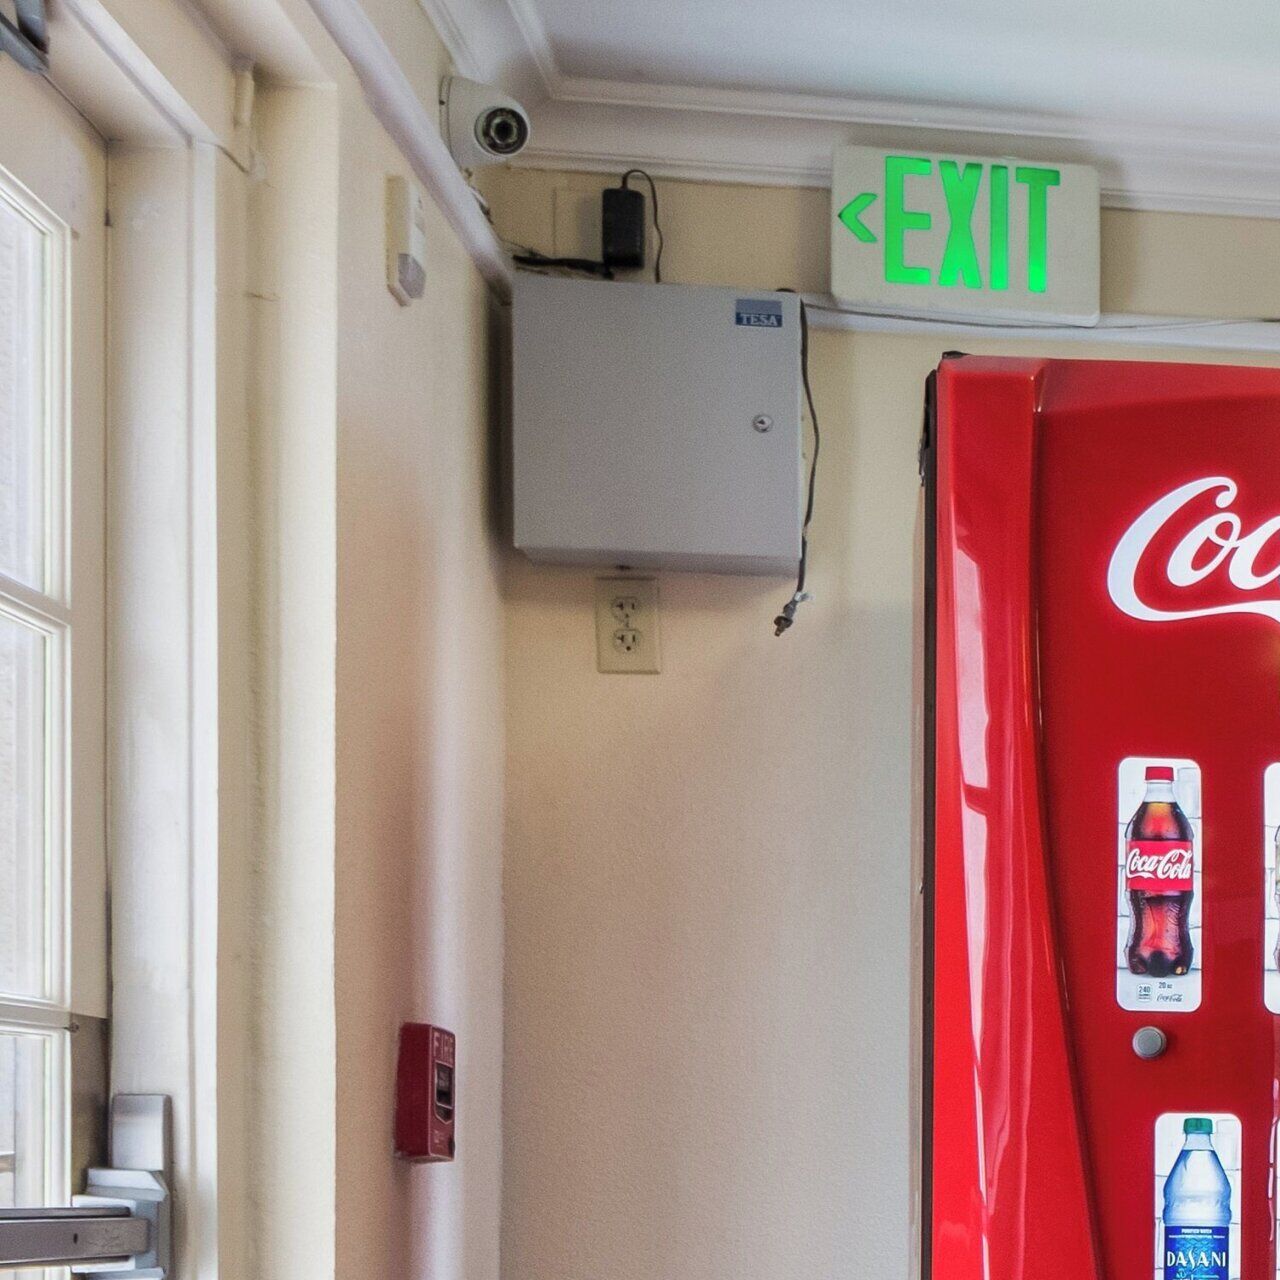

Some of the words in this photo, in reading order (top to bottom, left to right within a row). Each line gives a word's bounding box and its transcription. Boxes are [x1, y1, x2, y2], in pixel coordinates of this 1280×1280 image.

[886, 156, 1060, 294] EXIT
[736, 313, 781, 328] TESA
[1126, 848, 1192, 880] Coca-Cola
[1138, 986, 1151, 994] 240
[1166, 1249, 1226, 1268] DASANI
